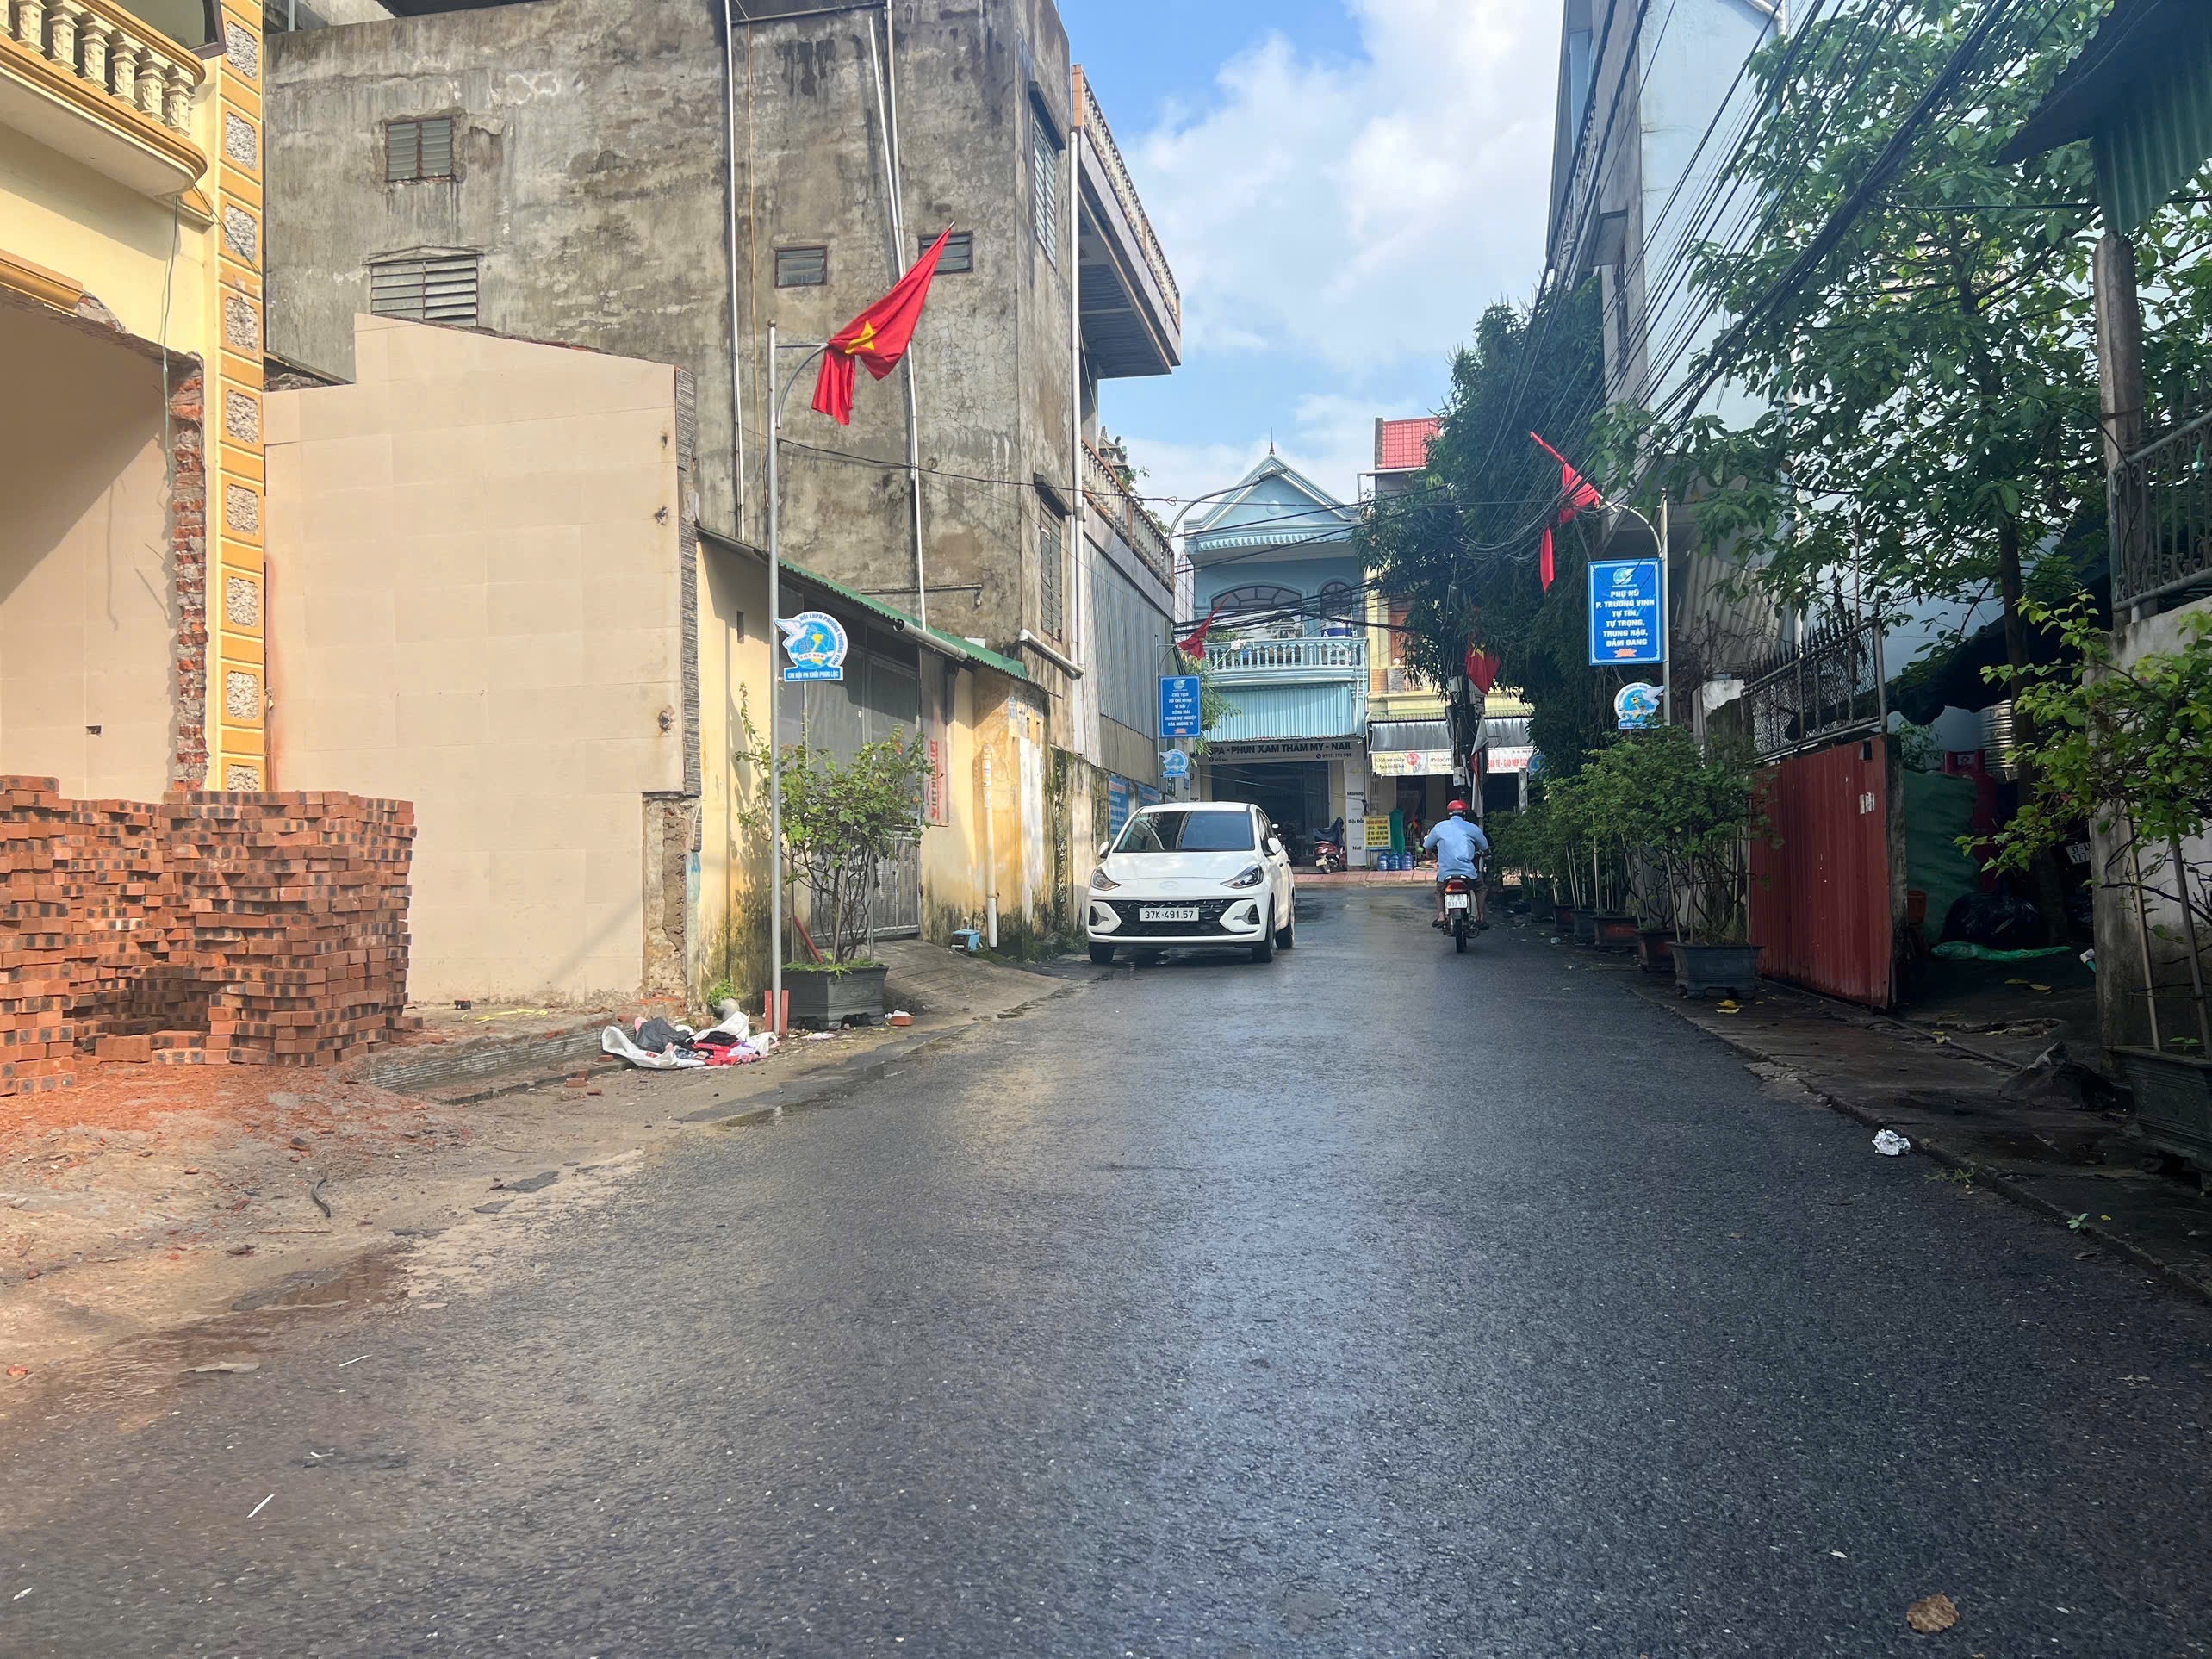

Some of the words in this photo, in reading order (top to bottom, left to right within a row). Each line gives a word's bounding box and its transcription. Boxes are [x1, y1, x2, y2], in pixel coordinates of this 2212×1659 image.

[1611, 590, 1626, 600] PHỤ
[1612, 610, 1623, 618] TỰ
[1606, 619, 1616, 628] TỰ
[1231, 745, 1255, 754] PHUN
[1332, 742, 1352, 750] NAIL
[1144, 910, 1194, 919] 37K-491.57
